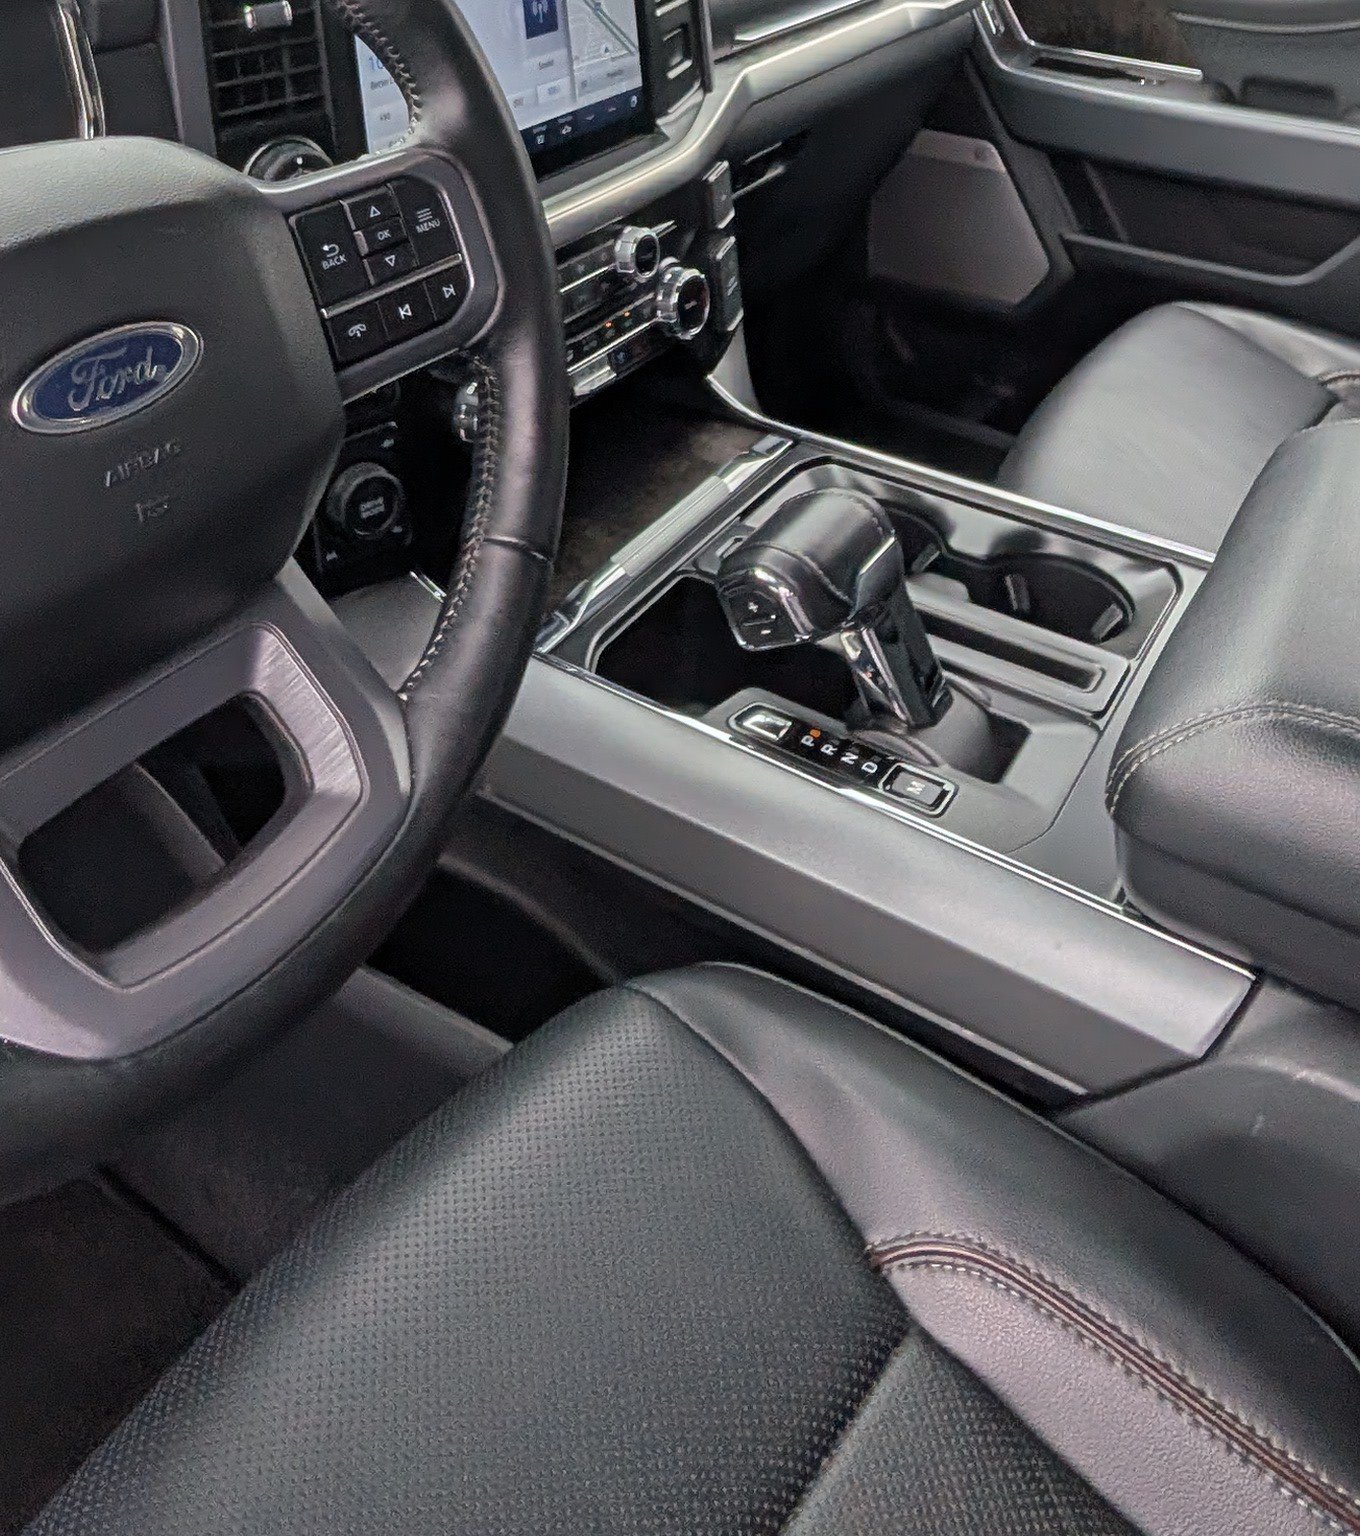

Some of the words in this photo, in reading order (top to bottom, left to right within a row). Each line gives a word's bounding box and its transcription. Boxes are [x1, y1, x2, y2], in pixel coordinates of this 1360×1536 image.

[415, 218, 441, 234] MENU
[377, 229, 391, 241] OK
[322, 253, 347, 271] BACK
[67, 345, 168, 412] Ford
[801, 735, 814, 747] P
[821, 744, 838, 756] R
[862, 762, 878, 773] D
